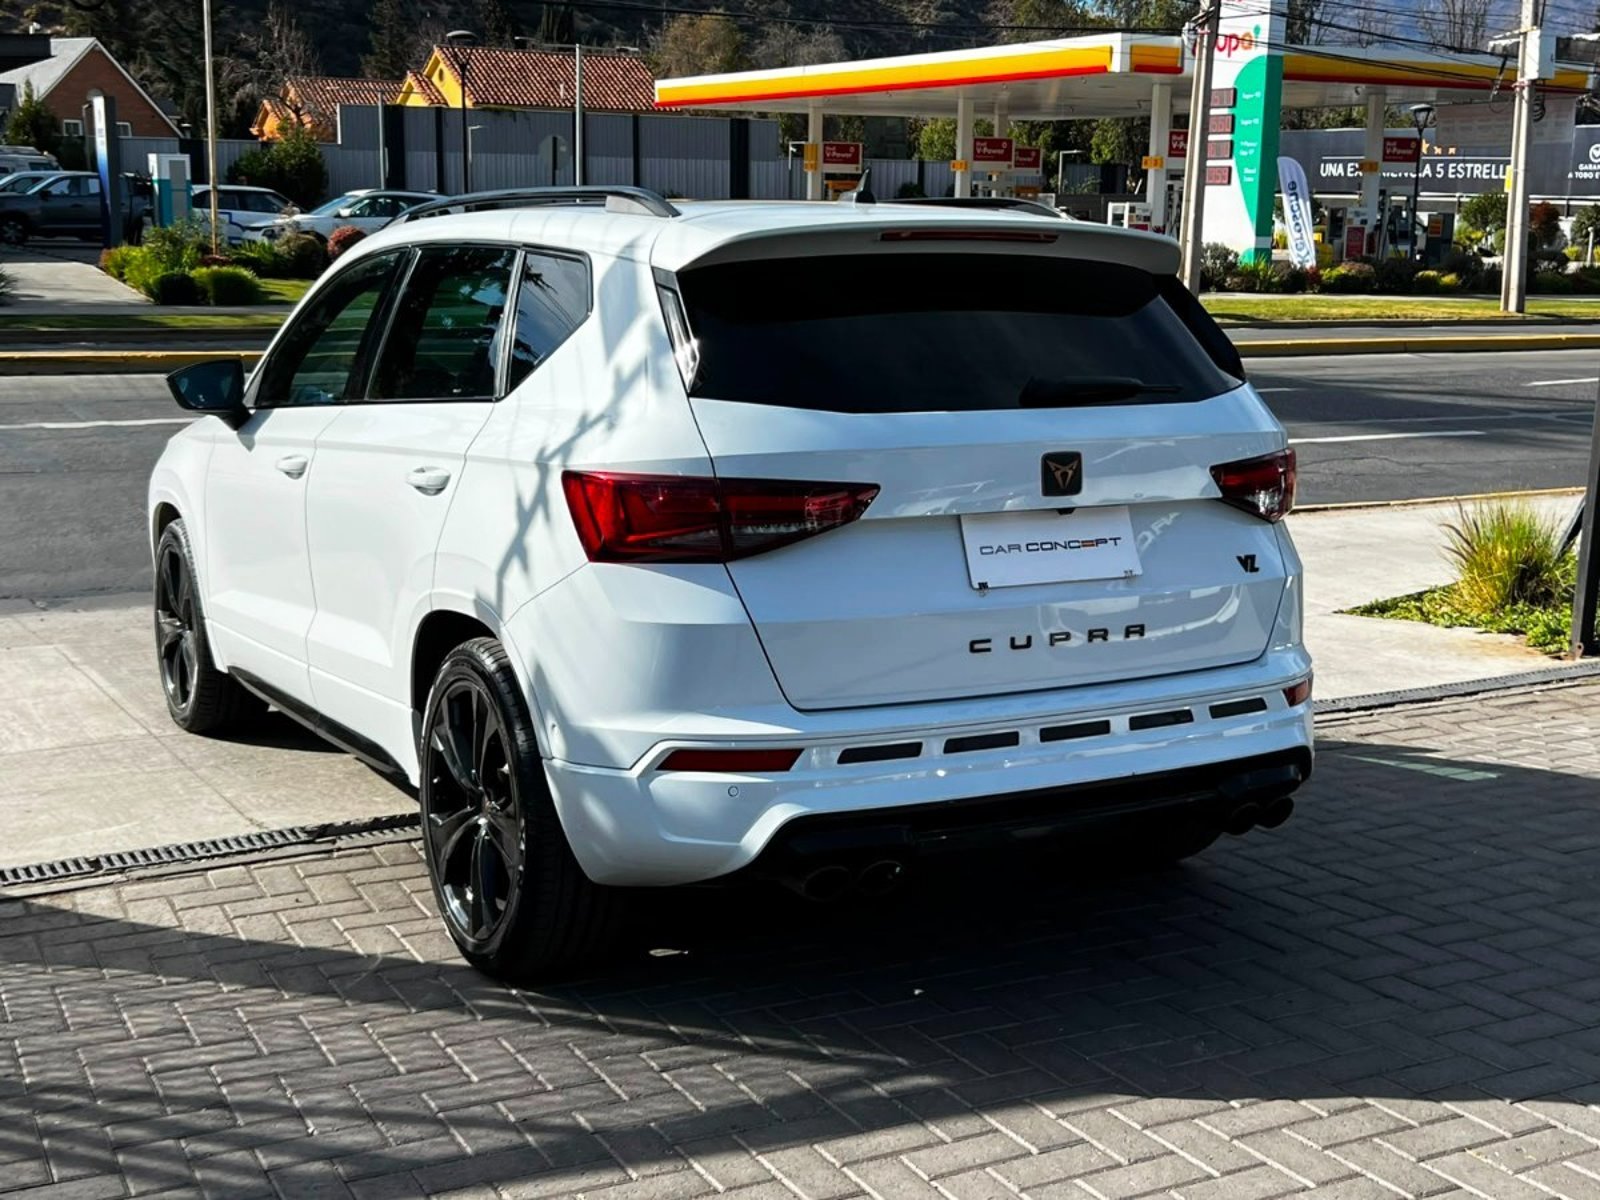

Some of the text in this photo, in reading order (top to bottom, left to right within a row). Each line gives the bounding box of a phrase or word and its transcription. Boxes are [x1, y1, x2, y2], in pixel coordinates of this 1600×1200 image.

[1320, 162, 1344, 177] UNA
[1436, 163, 1445, 178] 5
[1447, 163, 1508, 179] ESTRELL
[979, 536, 1122, 556] CAR CONCEPT
[969, 623, 1146, 653] CUPRA
